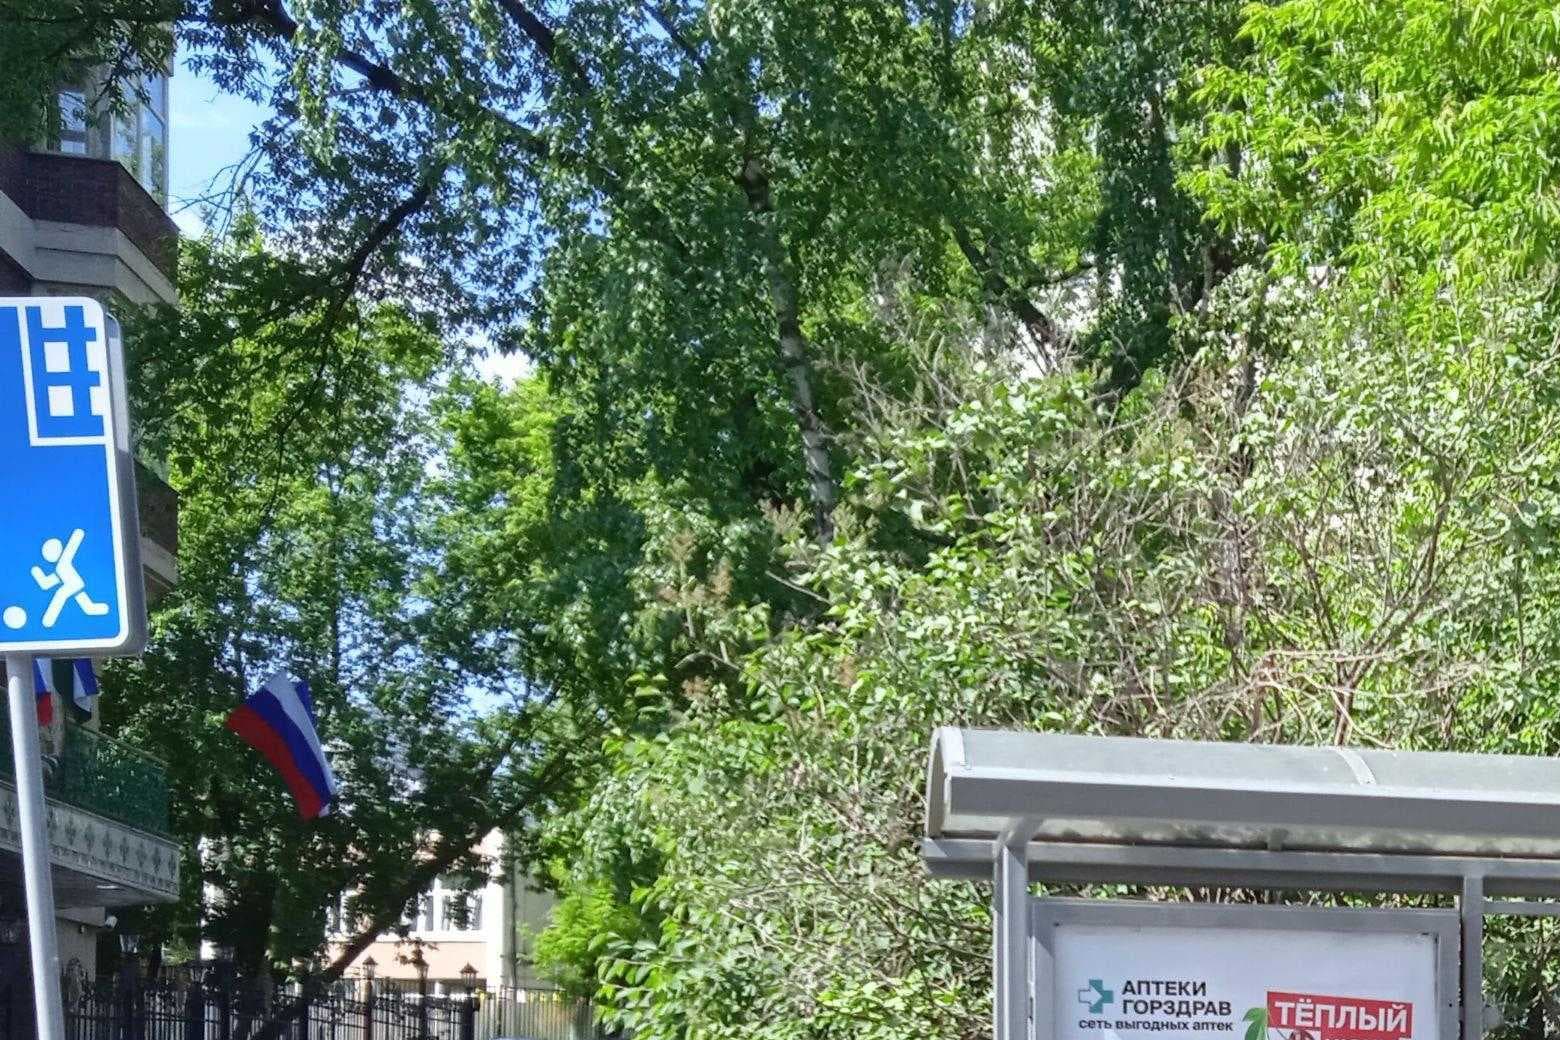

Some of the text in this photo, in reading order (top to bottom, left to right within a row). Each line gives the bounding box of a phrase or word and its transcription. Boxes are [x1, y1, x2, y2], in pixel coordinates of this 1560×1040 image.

[1121, 980, 1207, 997] АПТЕКИ
[1122, 1000, 1232, 1018] ГОРЗДРАВ
[1275, 998, 1407, 1033] ТЁПЛЫЙ
[1078, 1019, 1234, 1031] сеть выгодных аптек
